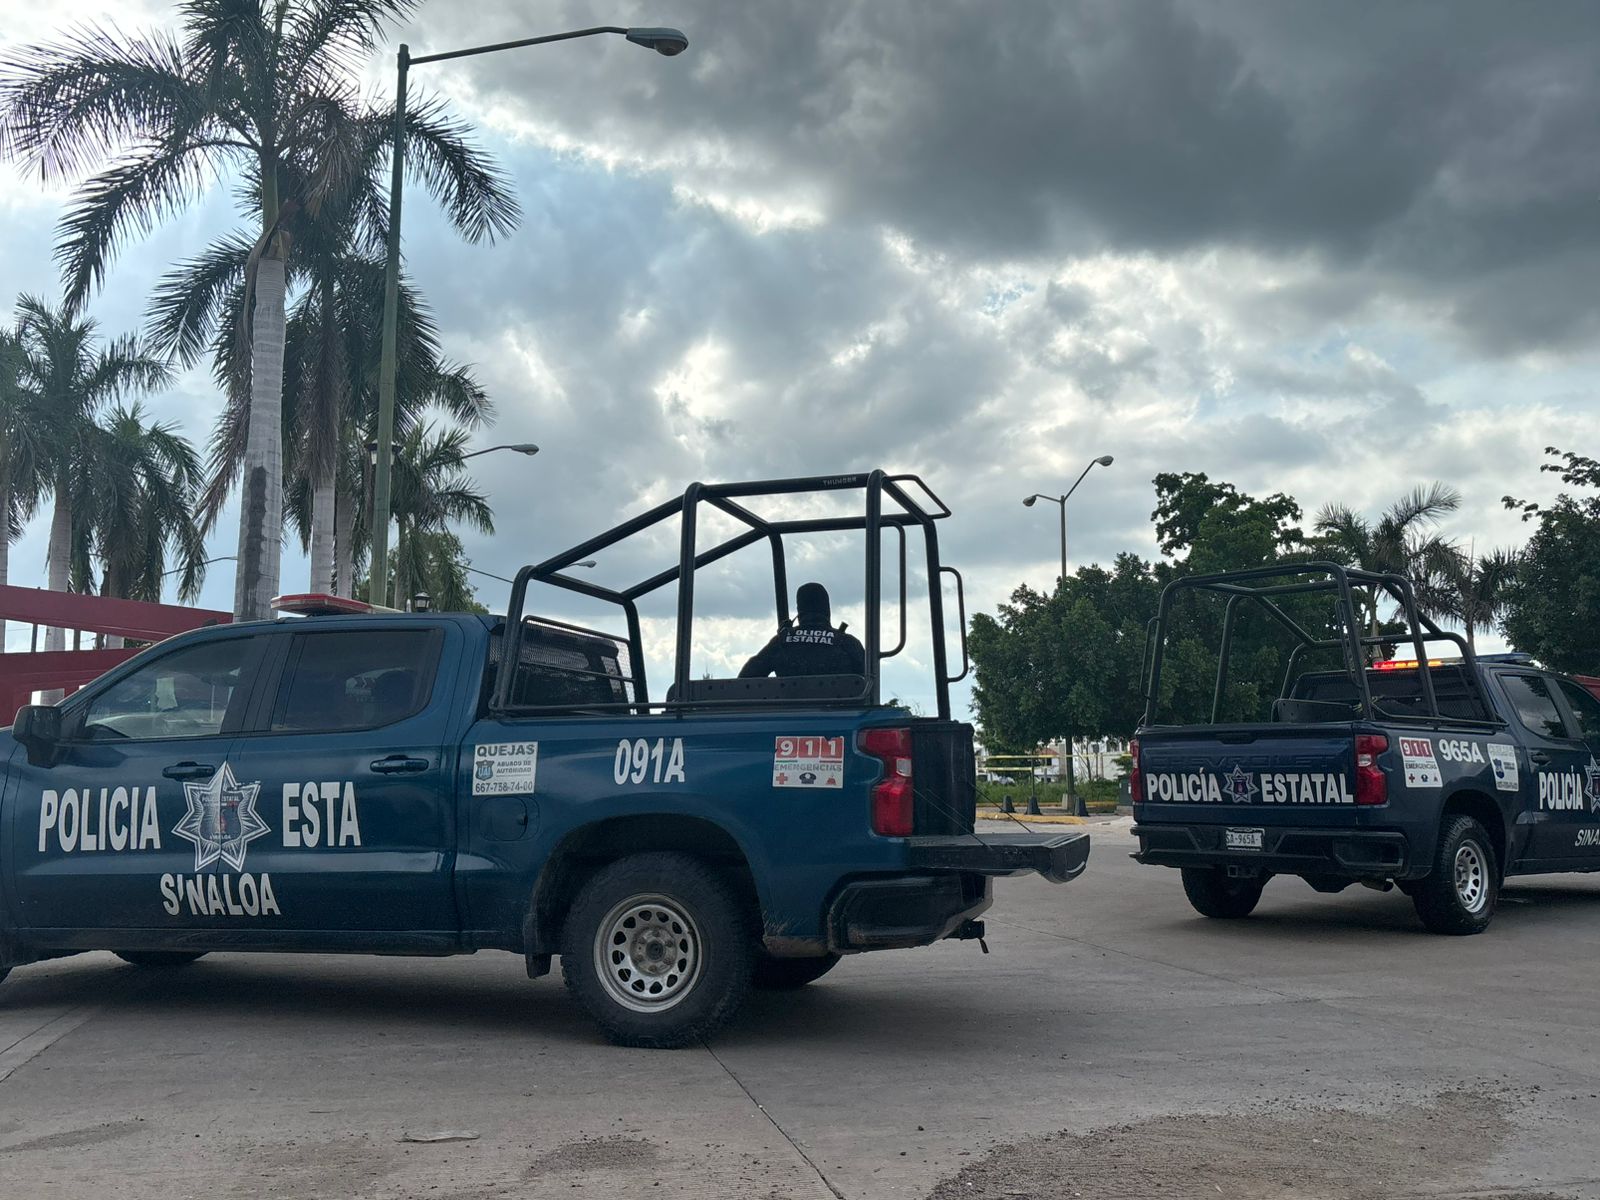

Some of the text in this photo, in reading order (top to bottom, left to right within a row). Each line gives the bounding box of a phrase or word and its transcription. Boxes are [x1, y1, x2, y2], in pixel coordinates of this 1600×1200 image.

[786, 636, 833, 645] ESTATAL
[476, 744, 535, 757] QUEJAS
[614, 737, 685, 785] 091A
[1438, 739, 1485, 764] 965A
[774, 763, 842, 772] EMERGENCIAS
[1146, 767, 1354, 803] POLICÍA ESTATAL
[1538, 764, 1584, 810] POLICÍA
[38, 781, 361, 852] POLICIA ESTA
[1574, 829, 1600, 846] SINA
[160, 872, 281, 916] SINALOA
